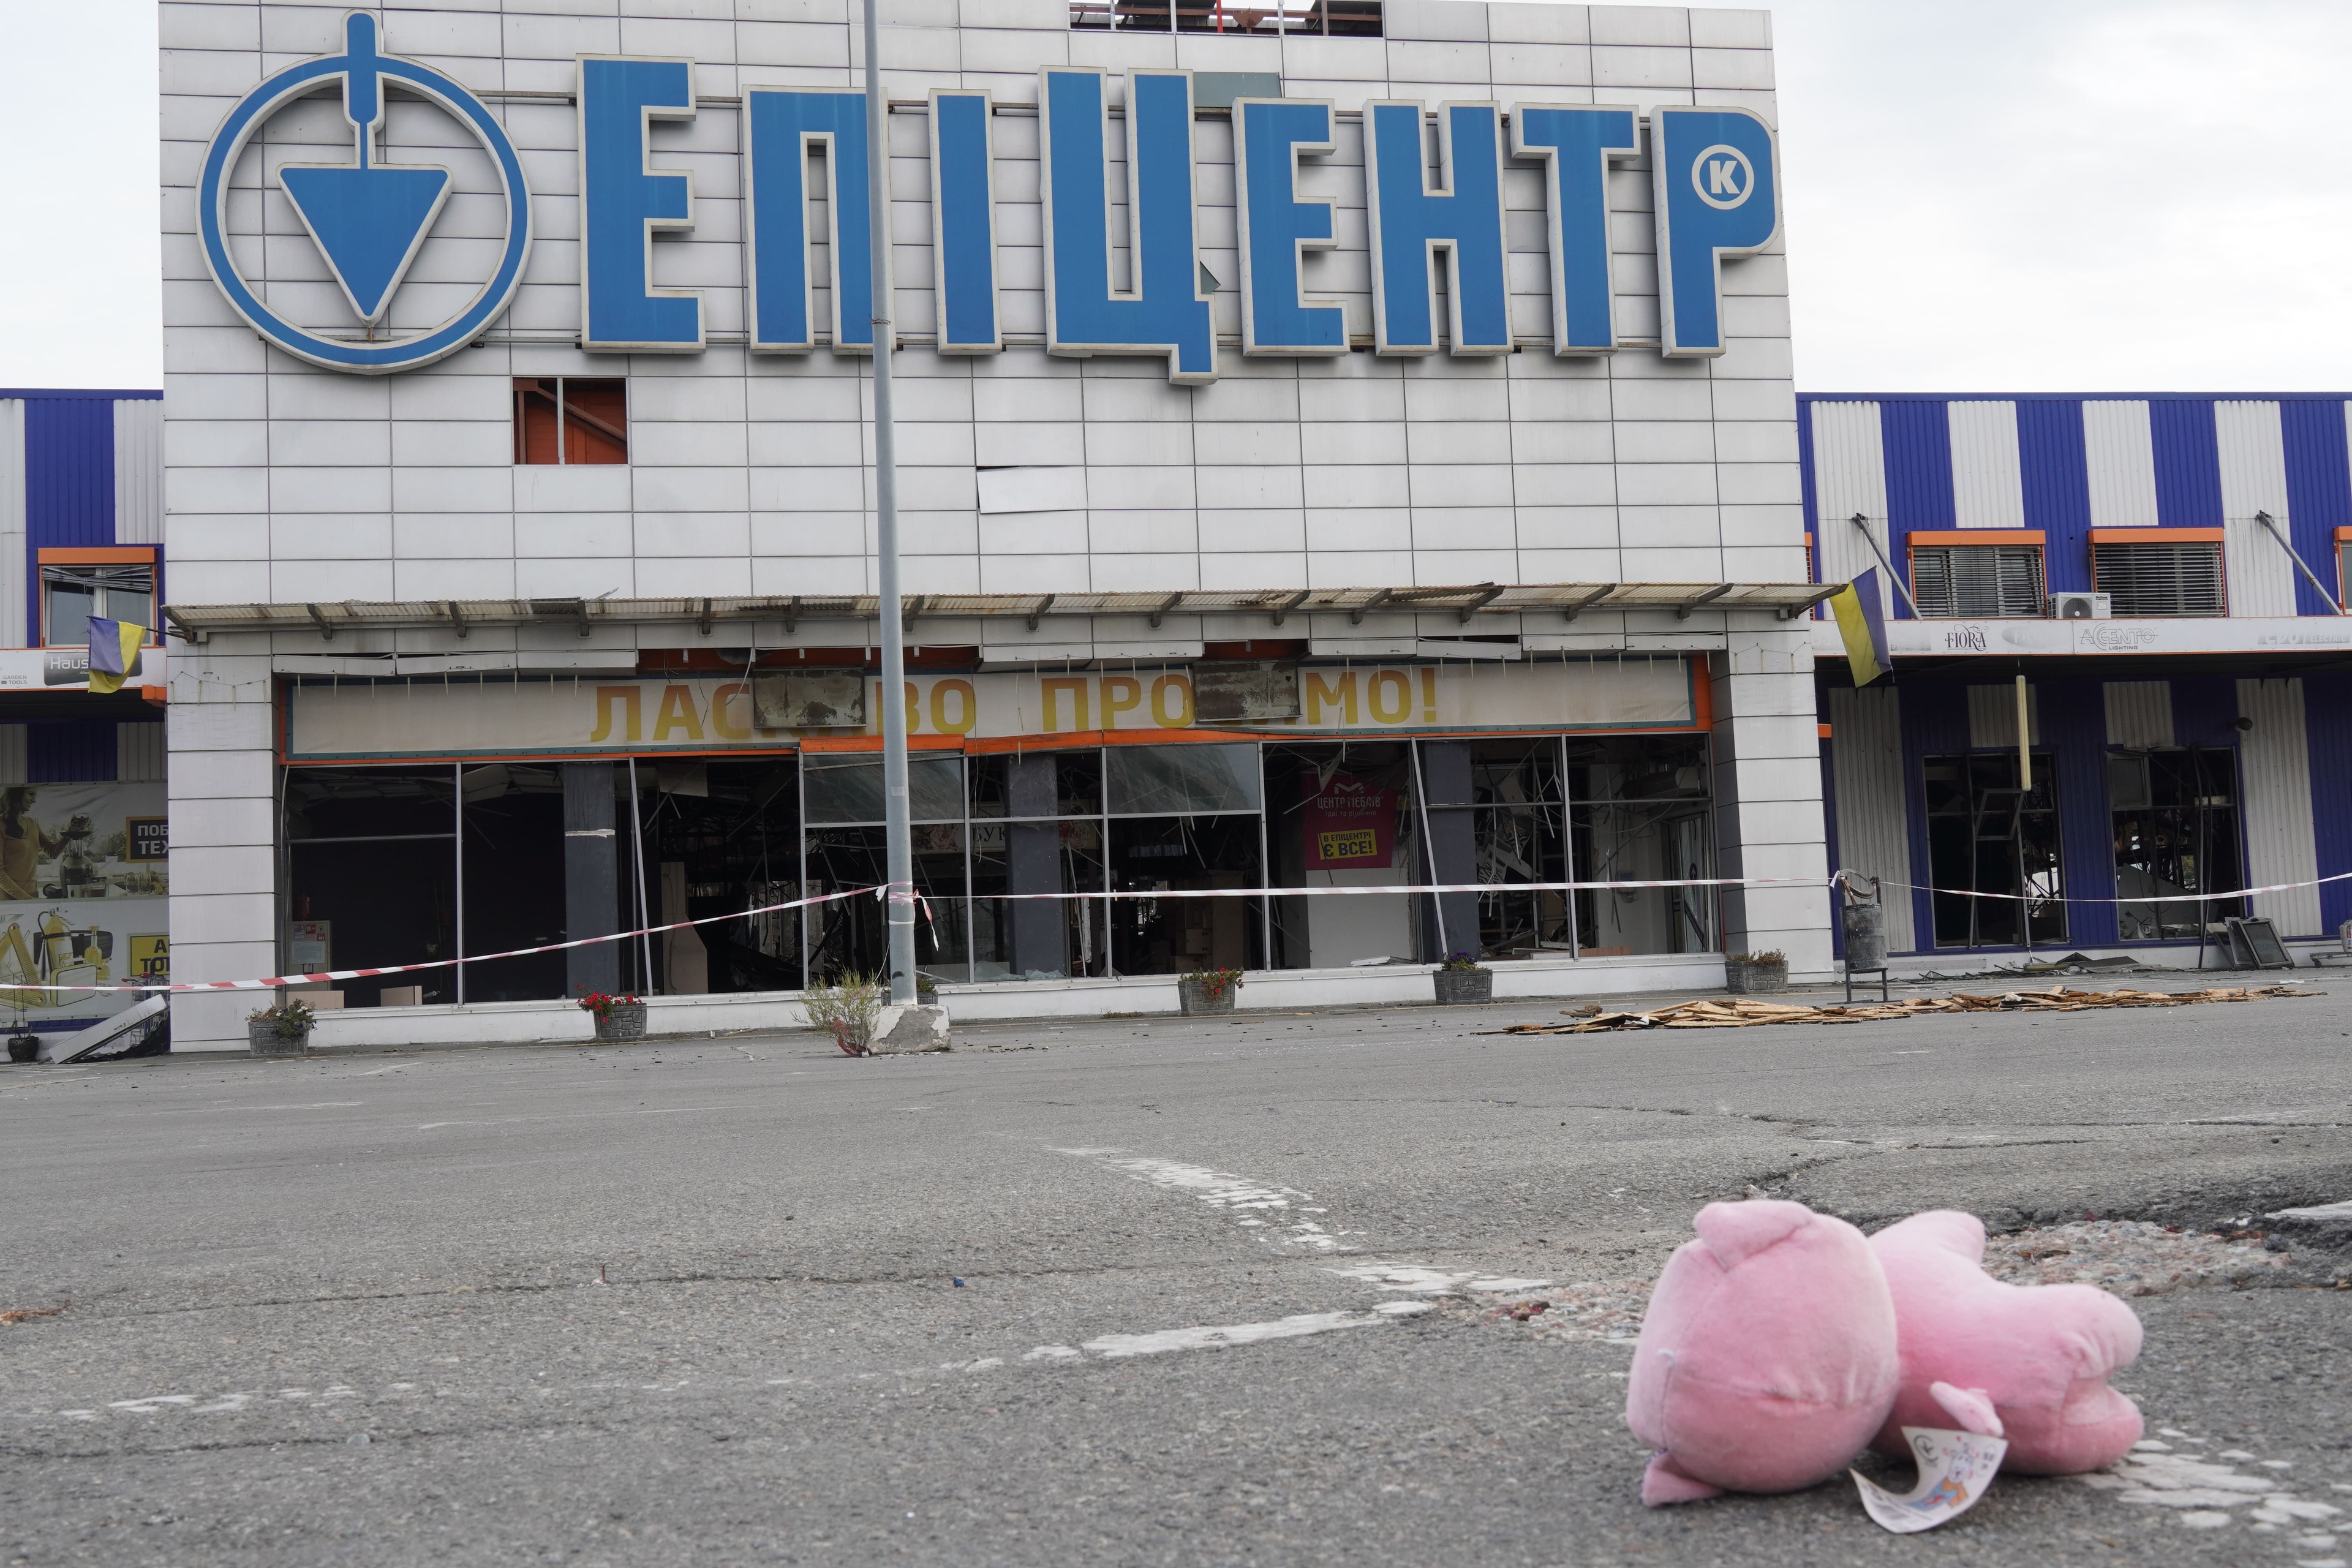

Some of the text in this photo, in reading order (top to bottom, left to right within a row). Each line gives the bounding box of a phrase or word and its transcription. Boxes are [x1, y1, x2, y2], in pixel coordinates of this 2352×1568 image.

[576, 53, 1779, 386] ЕПІЦЕНТР
[1945, 627, 1988, 651] FIORA
[590, 668, 1437, 743] ЛАСВО ПРОМО!
[1324, 840, 1373, 858] Є ВСЕ!
[1331, 832, 1371, 842] ЕПІЦЕНТРІ
